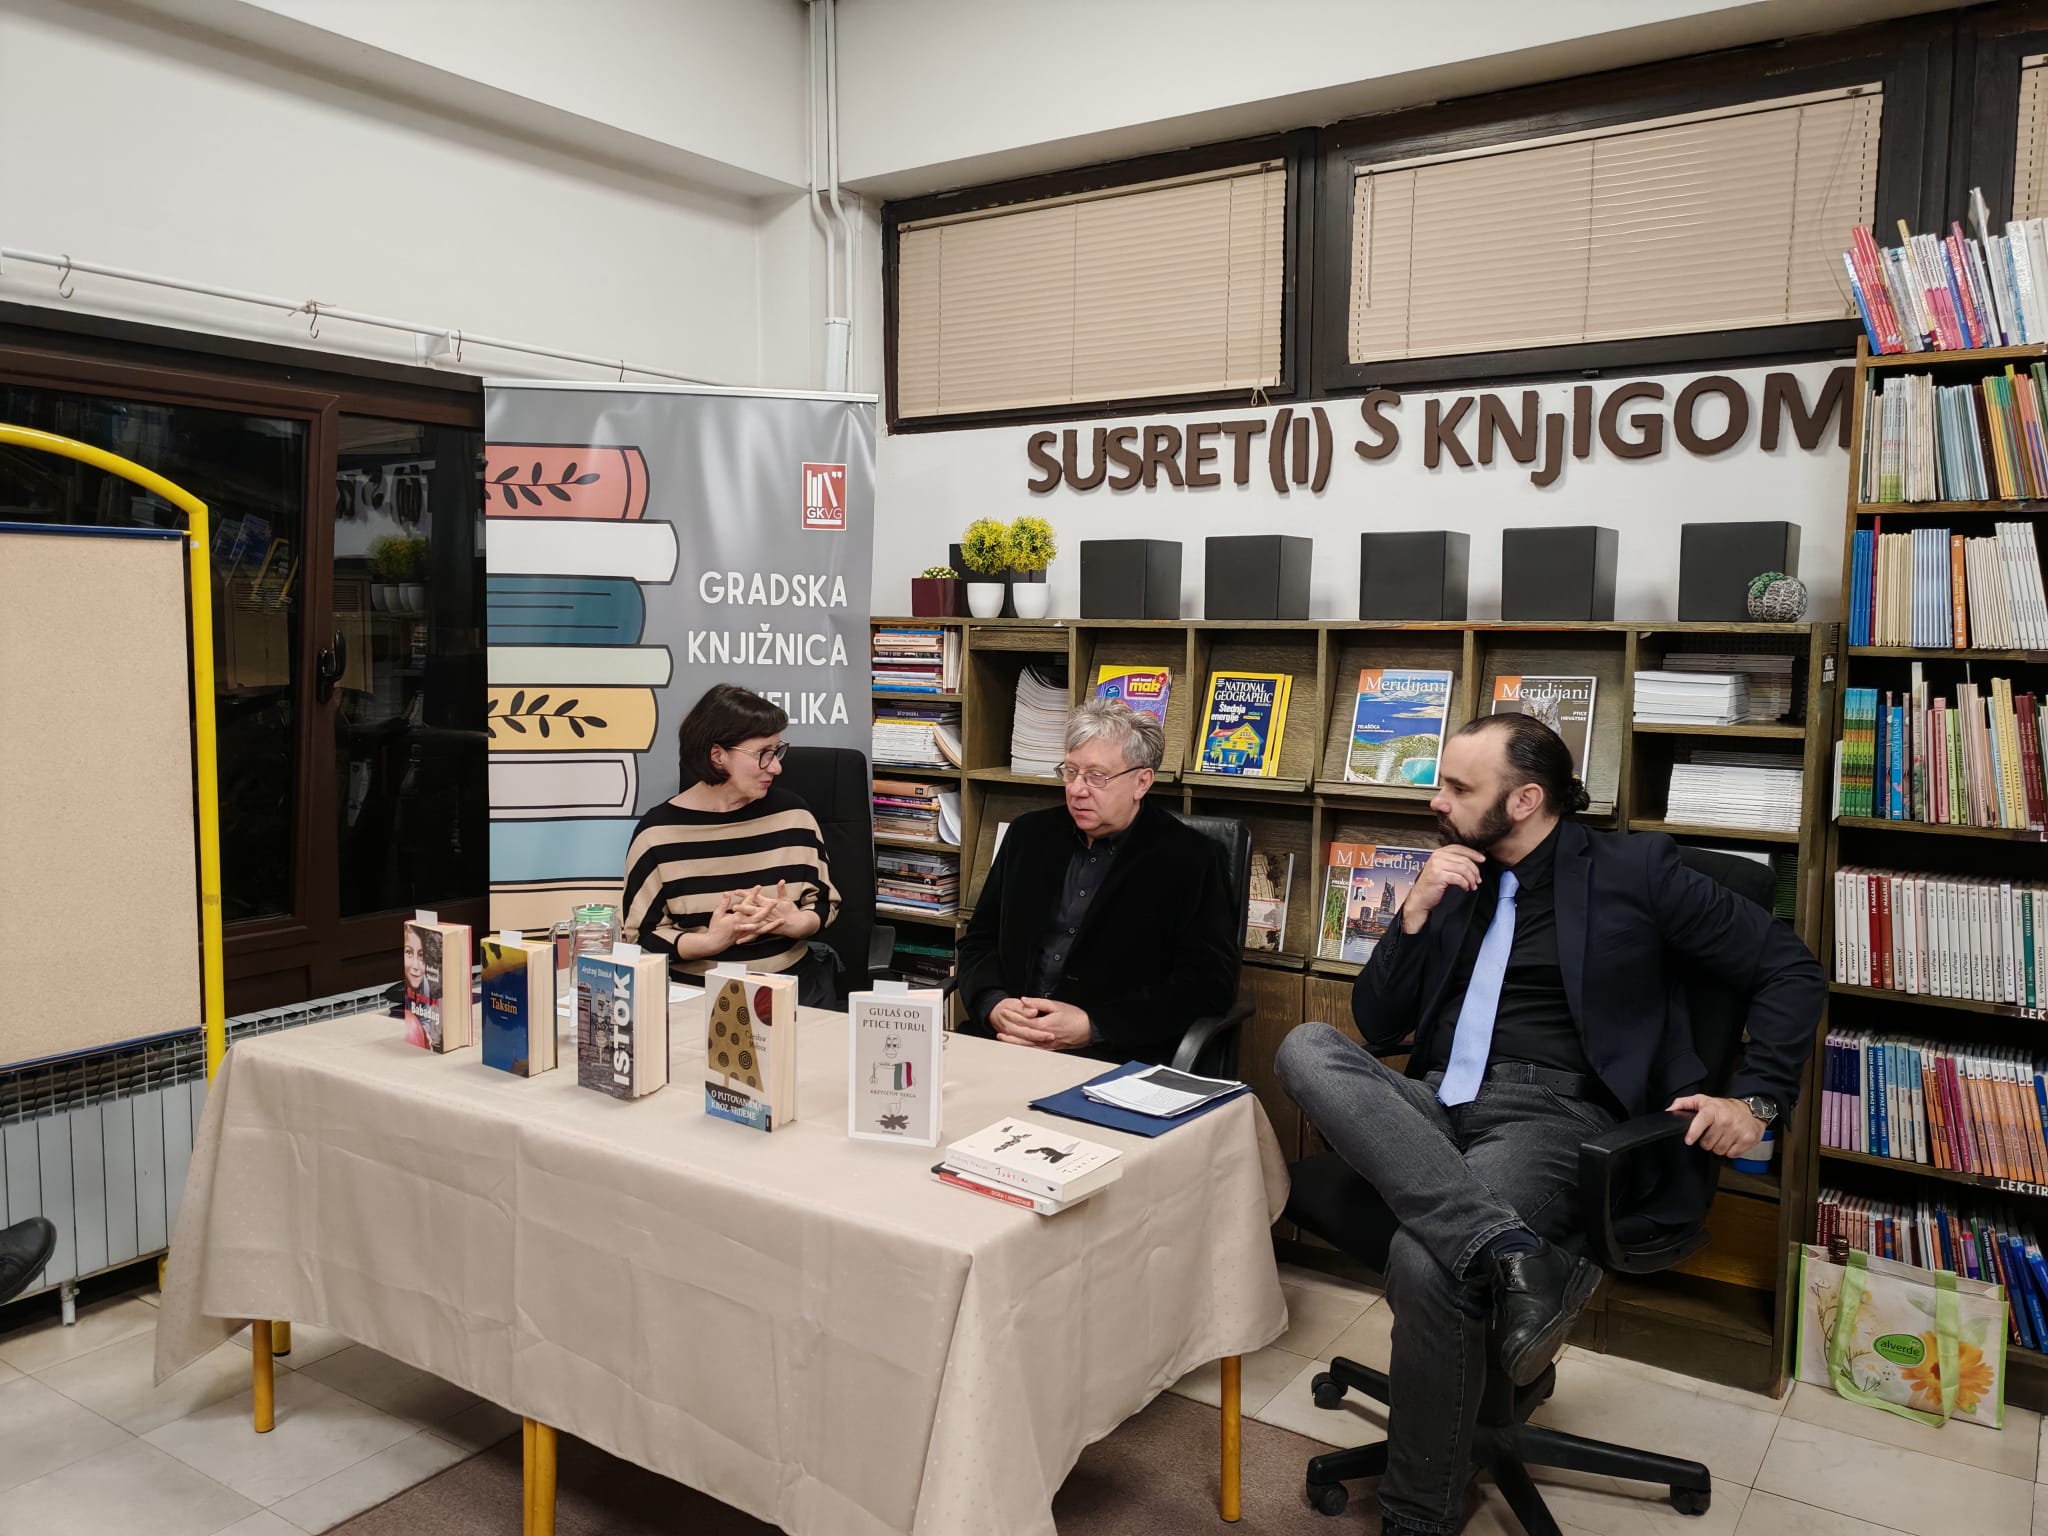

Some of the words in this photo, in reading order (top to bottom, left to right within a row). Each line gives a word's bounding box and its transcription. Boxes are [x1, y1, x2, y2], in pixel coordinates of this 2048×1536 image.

[1027, 406, 1334, 494] SUSRET(I)
[1354, 389, 1402, 461] S
[806, 507, 843, 520] GKVG
[699, 571, 848, 608] GRADSKA
[687, 623, 849, 666] KNJIŽNICA
[1128, 679, 1161, 693] mak
[1224, 681, 1266, 693] NATIONAL
[1365, 676, 1446, 696] Meridijani
[1214, 690, 1274, 704] GEOGRAPHIC
[1501, 683, 1589, 708] Meridijani
[758, 691, 849, 725] LIKA
[1218, 702, 1246, 715] Štednja
[1211, 713, 1239, 723] energije
[1359, 851, 1426, 875] Meridija
[411, 1001, 440, 1025] Babadag
[490, 997, 518, 1015] Taksim
[868, 1006, 901, 1019] GULAŠ
[903, 1009, 920, 1019] OD
[2020, 1007, 2047, 1021] LEK
[612, 970, 632, 1087] ISTOK
[862, 1019, 891, 1030] PTICE
[894, 1020, 927, 1032] TURUL
[711, 1089, 717, 1098] O
[2000, 1178, 2048, 1197] LEKTIR
[1880, 1340, 1921, 1357] alverde
